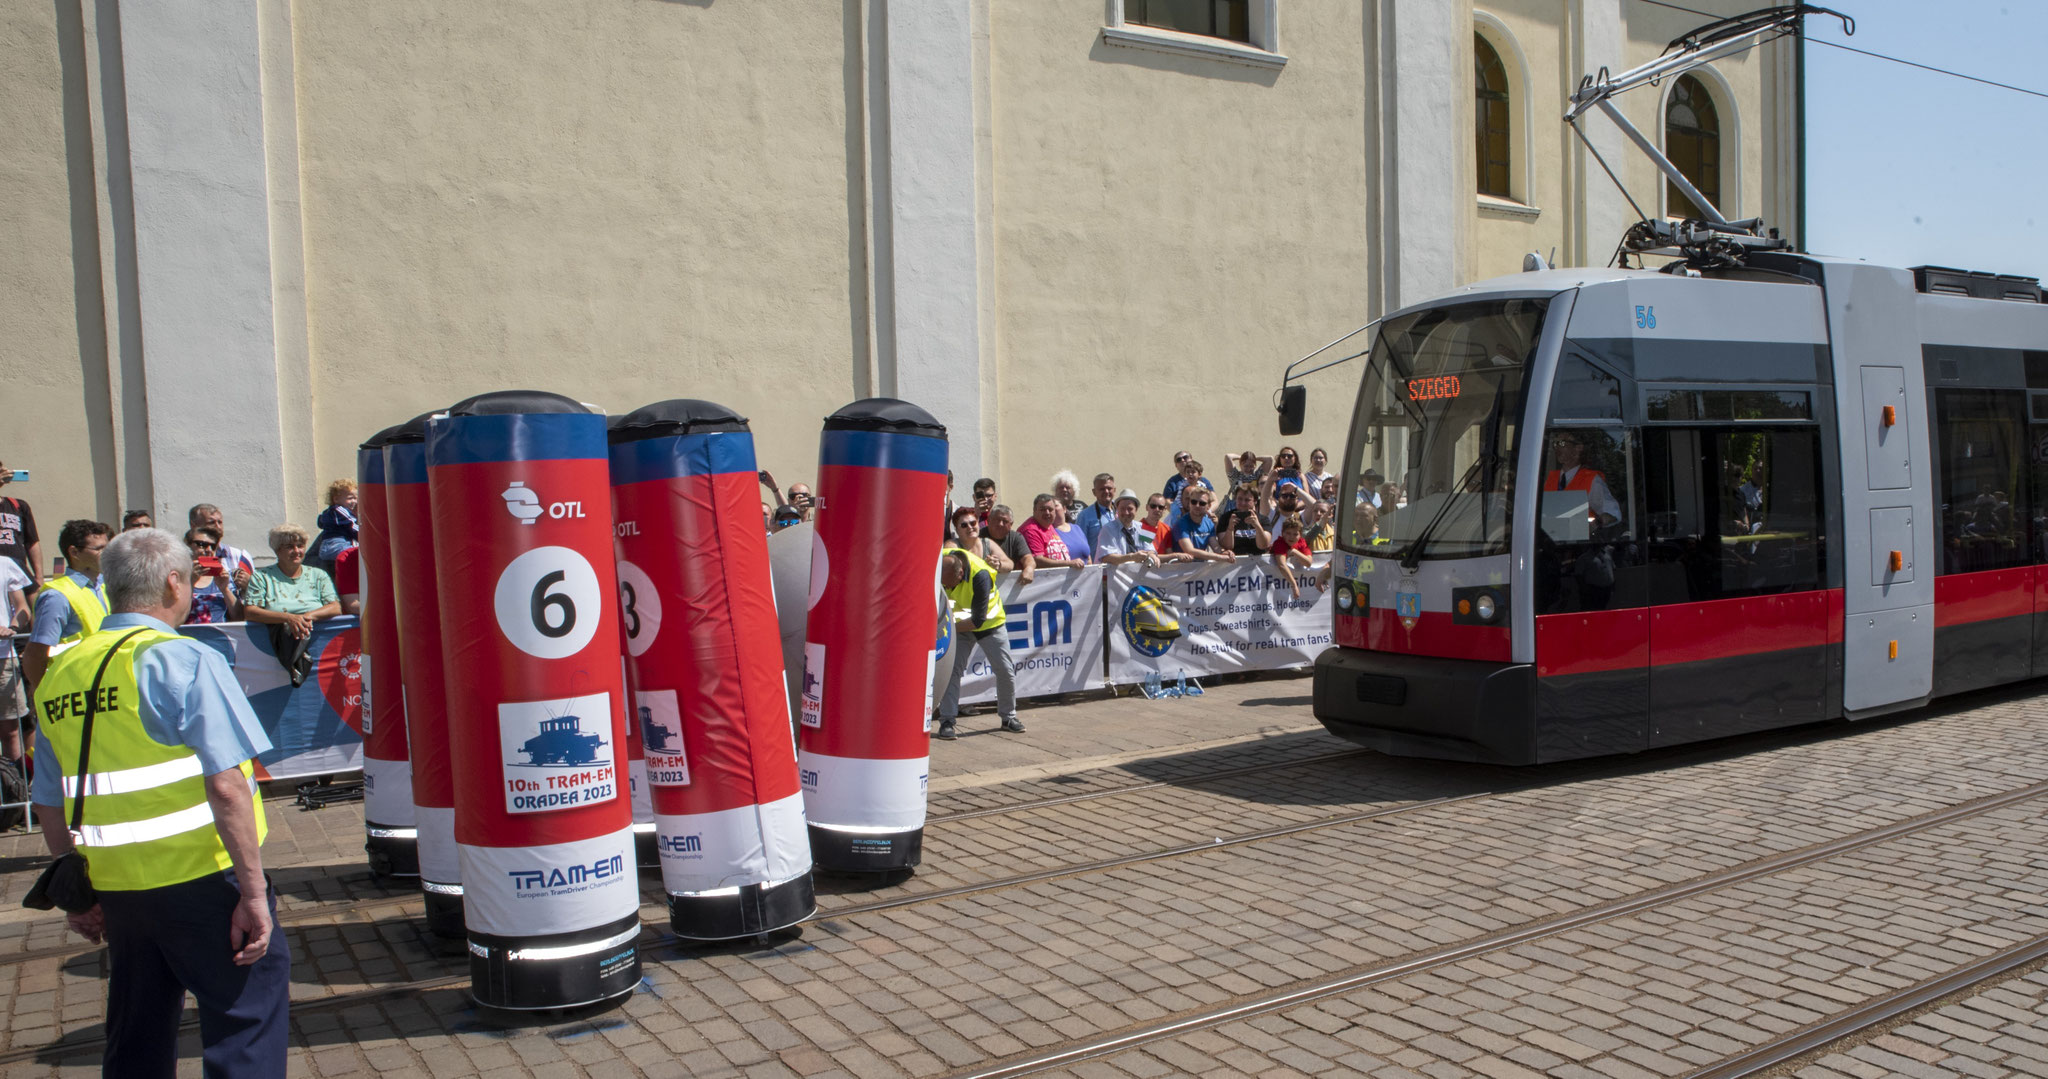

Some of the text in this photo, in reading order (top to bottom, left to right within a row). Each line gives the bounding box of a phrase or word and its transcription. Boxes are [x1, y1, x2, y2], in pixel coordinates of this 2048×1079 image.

[1635, 305, 1656, 329] 56
[1409, 376, 1460, 401] SZEGED
[549, 501, 586, 519] OTL
[617, 521, 641, 537] OTL
[1344, 555, 1359, 578] 56
[1185, 576, 1261, 596] TRAM-EM
[530, 570, 577, 638] 6
[621, 581, 641, 639] 3
[1185, 599, 1313, 617] T-Shirts, Basecaps, Hoodies,
[1187, 623, 1212, 635] Cups,
[1213, 618, 1270, 631] Sweatshirts
[1191, 632, 1332, 655] Hot stuff for real tram fans!
[972, 652, 1073, 676] Chpionship
[43, 686, 119, 725] REFEEE
[508, 779, 540, 793] 10th
[546, 767, 613, 790] TRAM-EM
[660, 771, 684, 782] 2023
[514, 791, 579, 809] ORADEA
[584, 784, 612, 801] 2023
[508, 854, 623, 890] TRAM-EM
[516, 875, 624, 900] European TramDriver Championship
